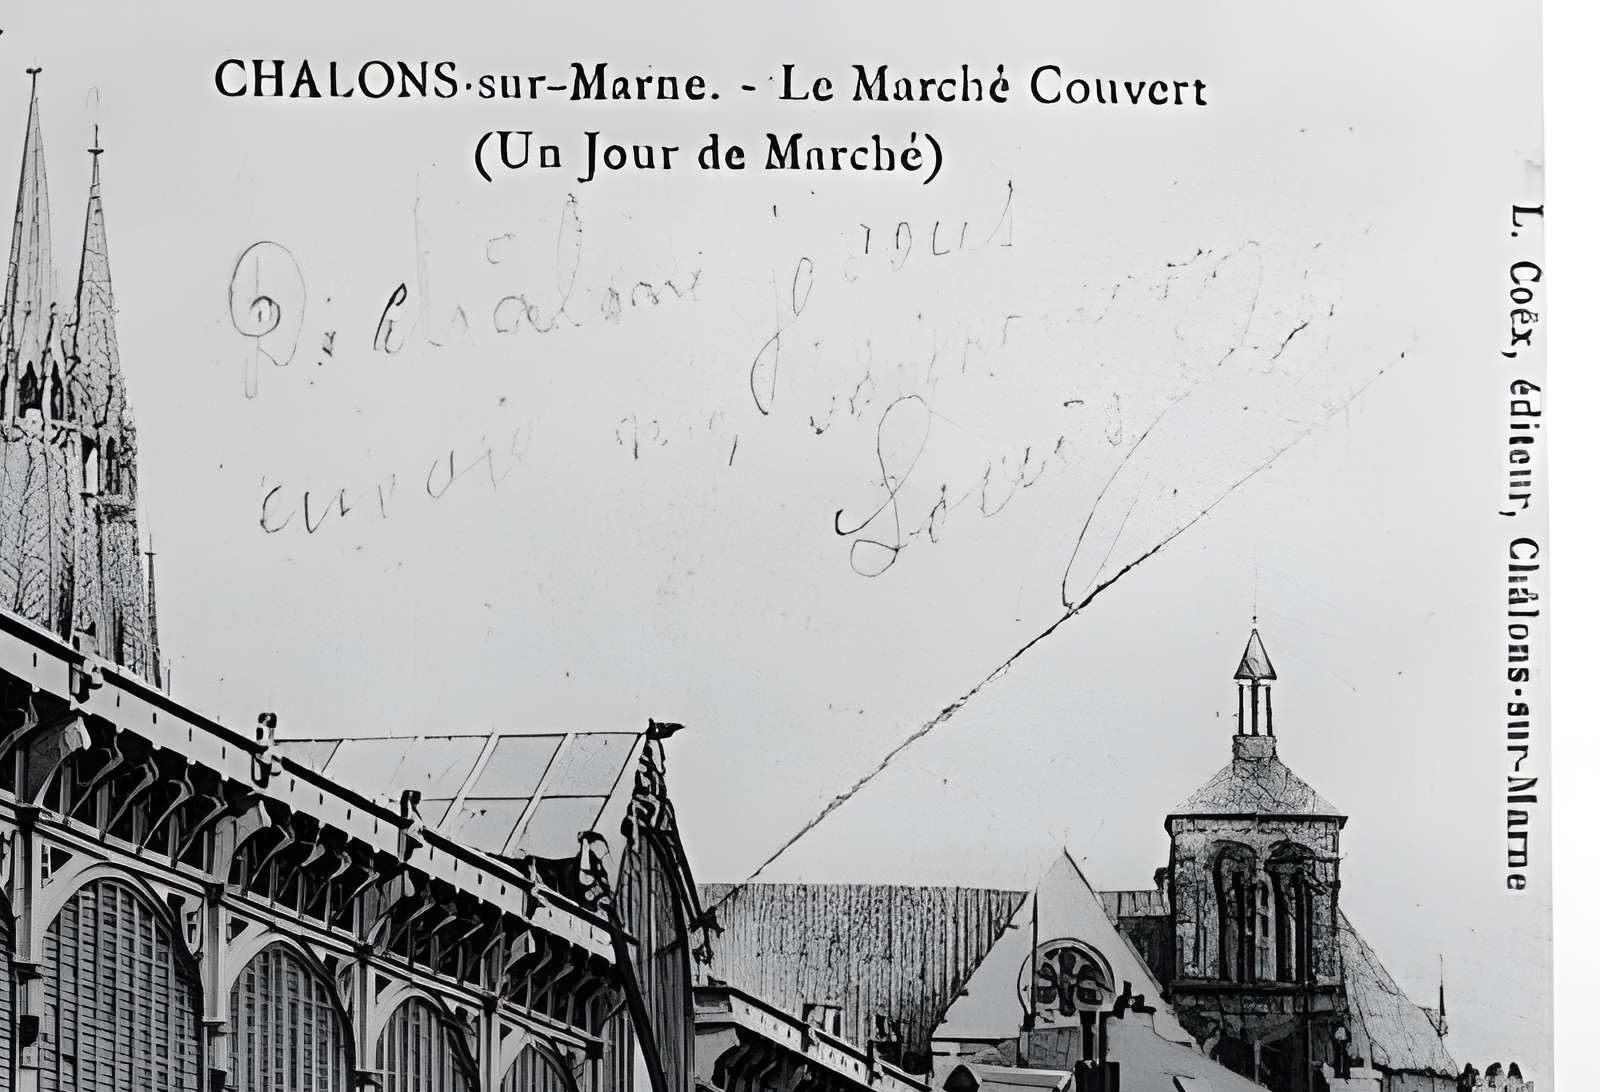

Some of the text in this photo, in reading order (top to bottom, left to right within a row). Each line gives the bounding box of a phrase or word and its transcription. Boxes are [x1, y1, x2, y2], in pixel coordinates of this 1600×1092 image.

[779, 64, 833, 101] Le
[852, 64, 1009, 103] Marché
[1031, 65, 1207, 105] Couvert
[475, 131, 942, 184] (Un Jour de Marché)
[1511, 205, 1543, 237] L.
